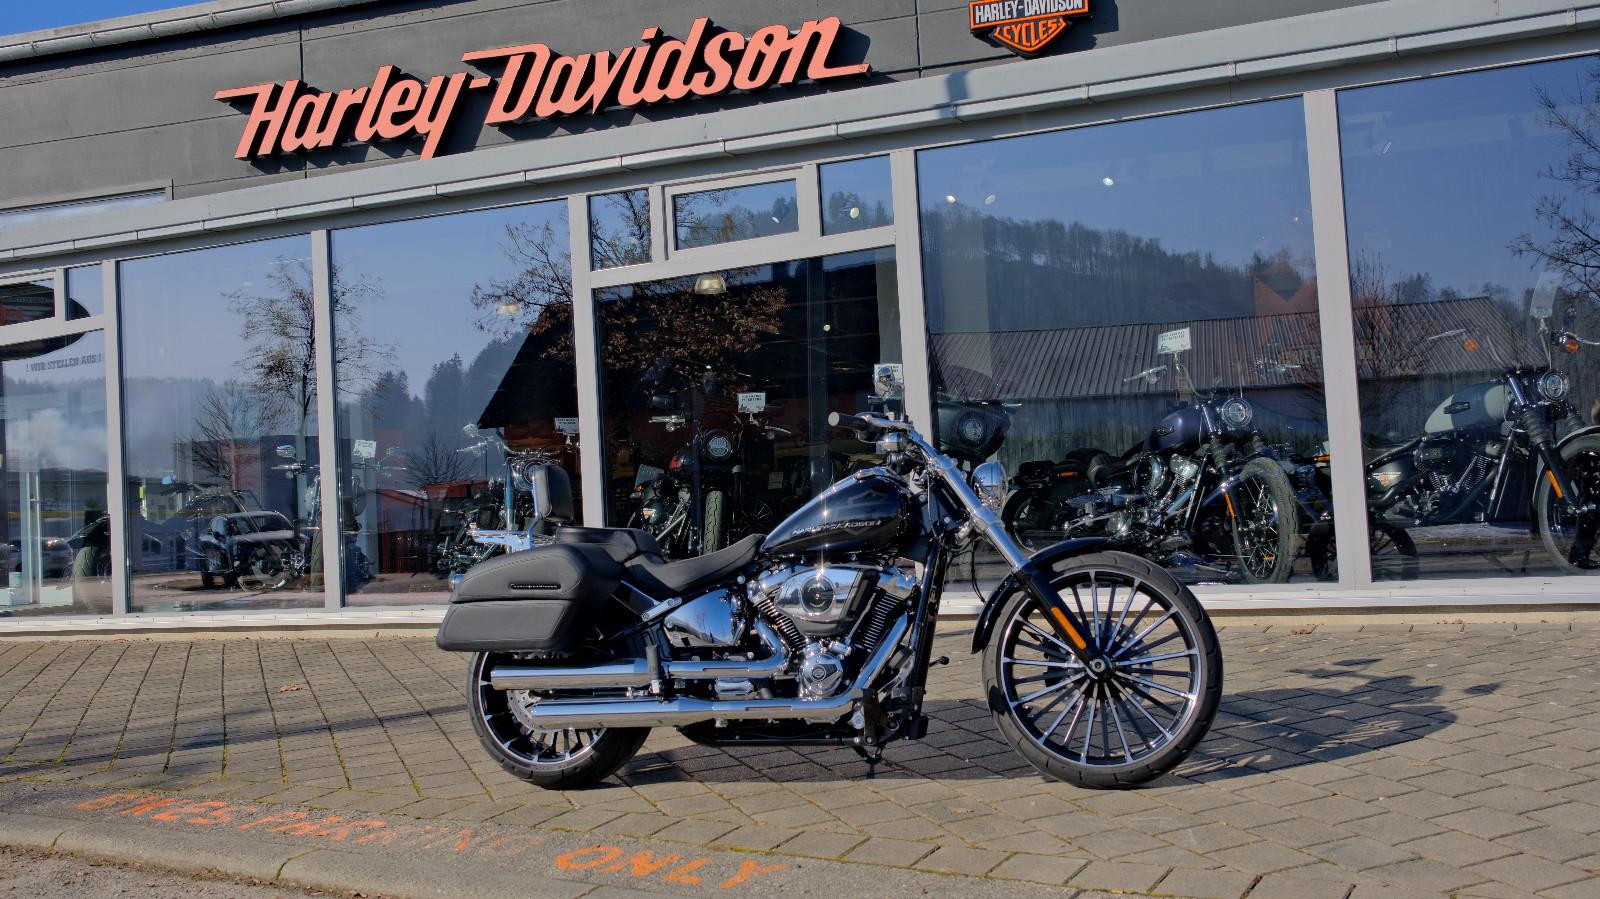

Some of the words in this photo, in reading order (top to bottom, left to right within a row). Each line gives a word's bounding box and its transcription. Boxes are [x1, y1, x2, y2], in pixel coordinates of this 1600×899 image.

[1003, 19, 1058, 47] CYCLES
[214, 16, 871, 160] Harley-Davidson
[554, 846, 789, 890] ONLY
